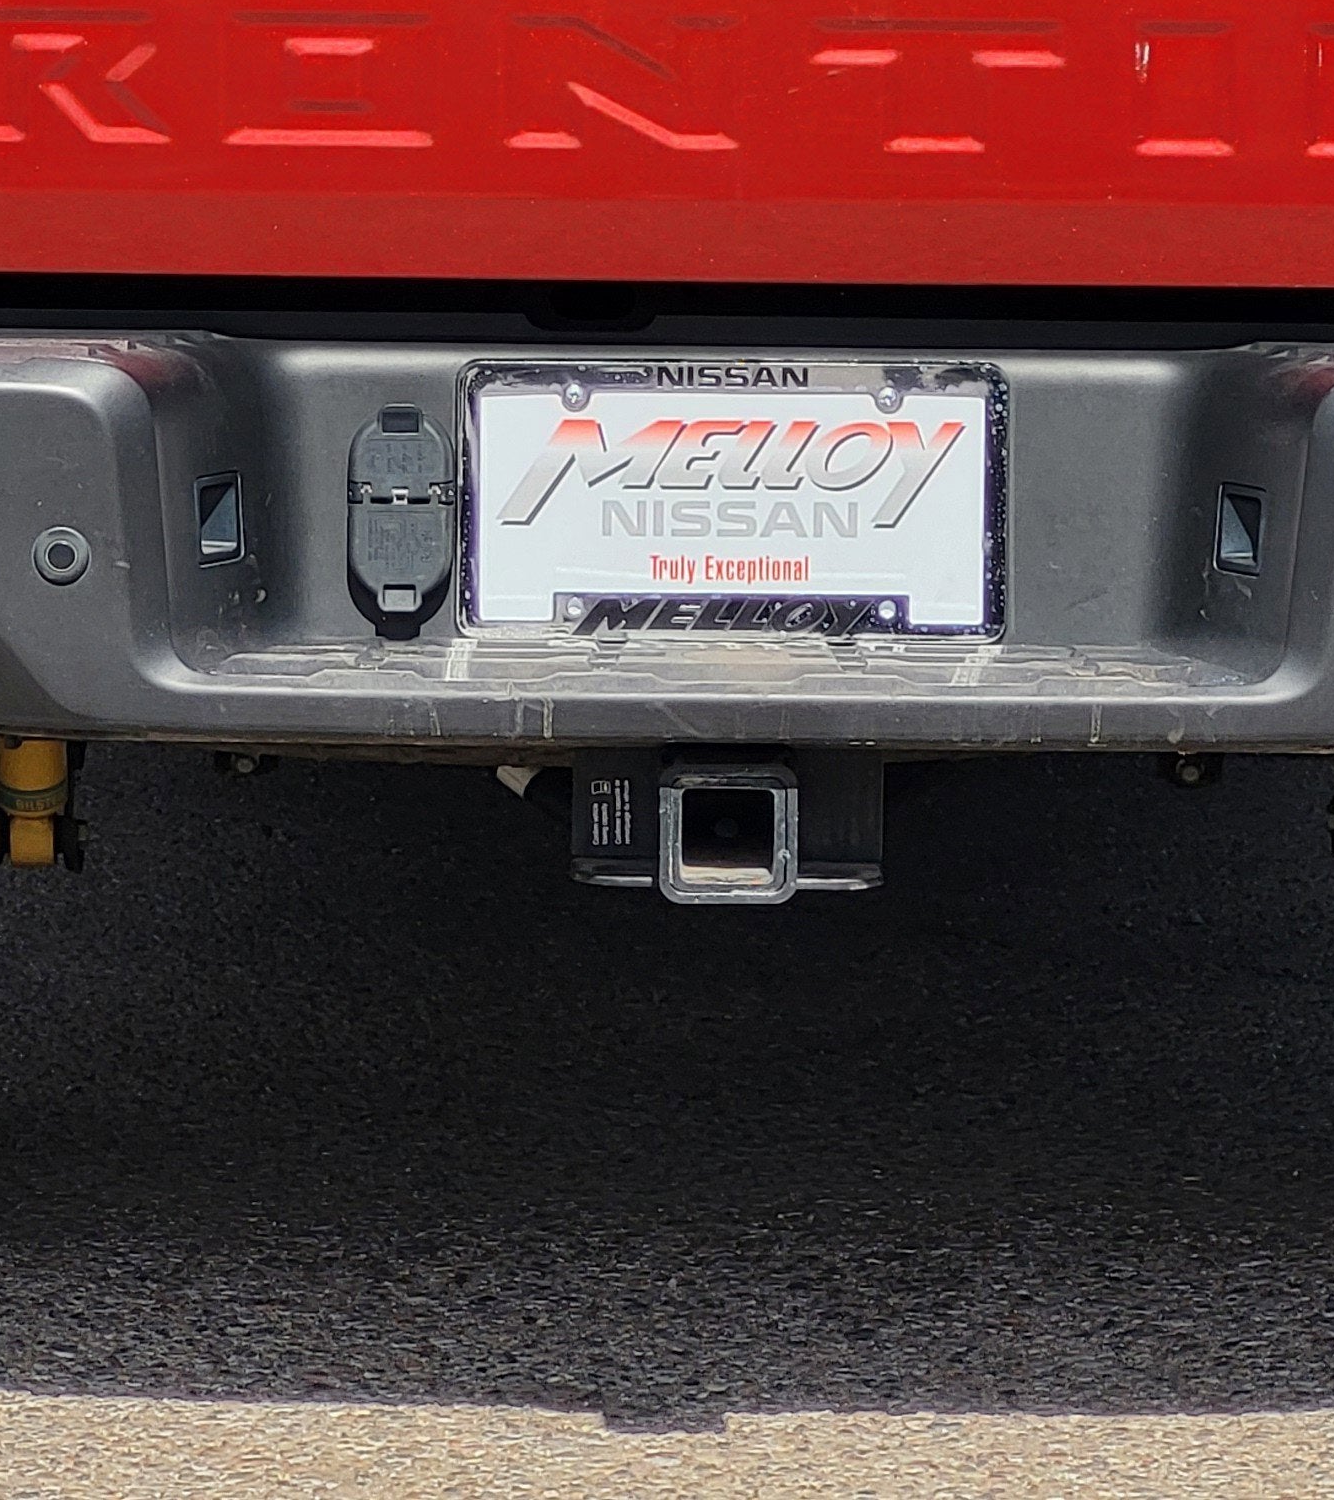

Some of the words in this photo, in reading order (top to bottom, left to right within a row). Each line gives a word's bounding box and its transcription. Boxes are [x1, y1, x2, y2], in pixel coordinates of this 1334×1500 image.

[655, 366, 810, 388] NISSAN
[496, 419, 966, 528] MELLOY
[601, 500, 859, 538] NISSAN
[650, 555, 696, 584] Truly
[705, 555, 809, 584] Exceptional
[569, 598, 875, 636] MELLOY
